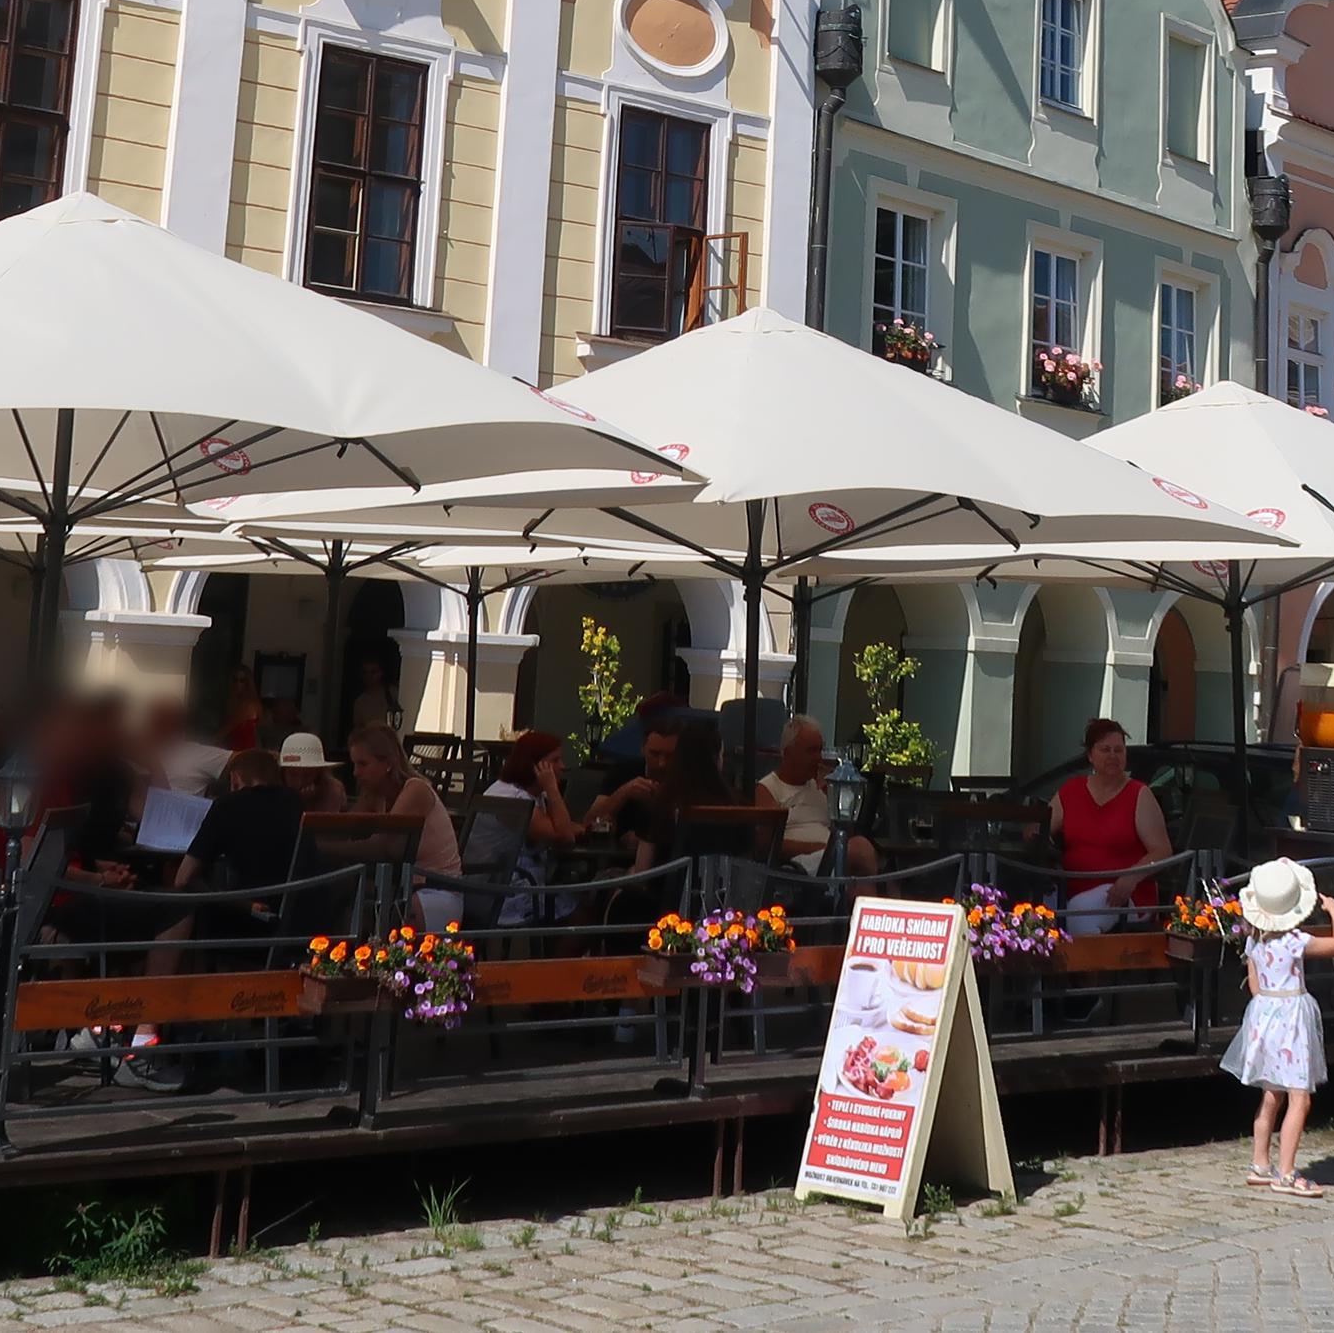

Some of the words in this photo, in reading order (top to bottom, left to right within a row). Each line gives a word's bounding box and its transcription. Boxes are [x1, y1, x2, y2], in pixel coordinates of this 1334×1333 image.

[861, 914, 905, 933] NABÍDKA
[906, 917, 949, 937] SNÍDANÍ
[856, 936, 862, 952] I
[862, 936, 885, 954] PRO
[886, 937, 944, 960] VEŘEJNOST
